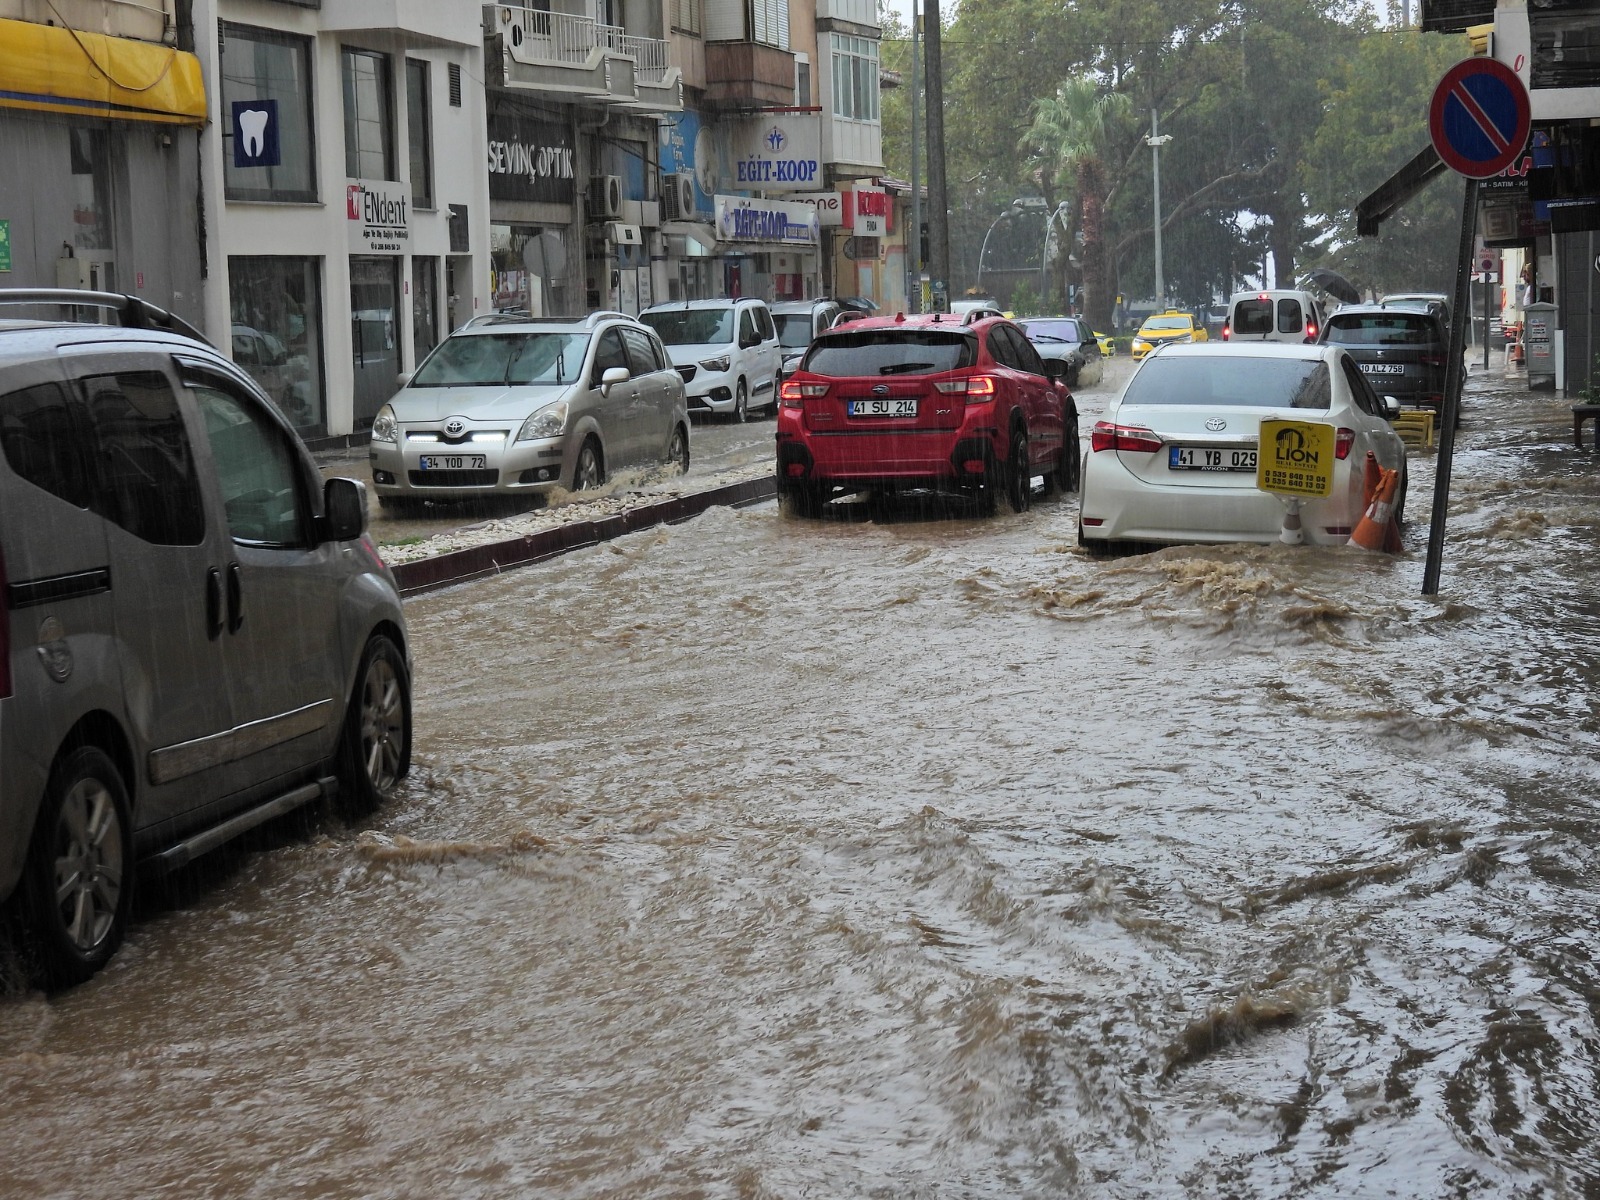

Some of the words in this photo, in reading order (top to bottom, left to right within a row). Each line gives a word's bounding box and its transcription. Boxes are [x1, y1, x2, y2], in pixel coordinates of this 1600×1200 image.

[488, 133, 536, 184] SEVİNÇ
[537, 139, 574, 178] OPTİK
[737, 153, 817, 181] EĞİT-KOOP
[364, 191, 406, 224] ENdent
[734, 200, 788, 239] EĞİT-KOOP
[1372, 364, 1387, 372] ALZ
[1388, 364, 1403, 372] 758
[854, 401, 865, 413] 41
[872, 401, 889, 413] SU
[896, 401, 914, 412] 214
[427, 458, 439, 468] 34
[471, 458, 484, 468] 72
[1179, 450, 1193, 464] 41
[1206, 451, 1221, 465] YB
[1232, 452, 1257, 466] 029
[1276, 447, 1319, 464] LION
